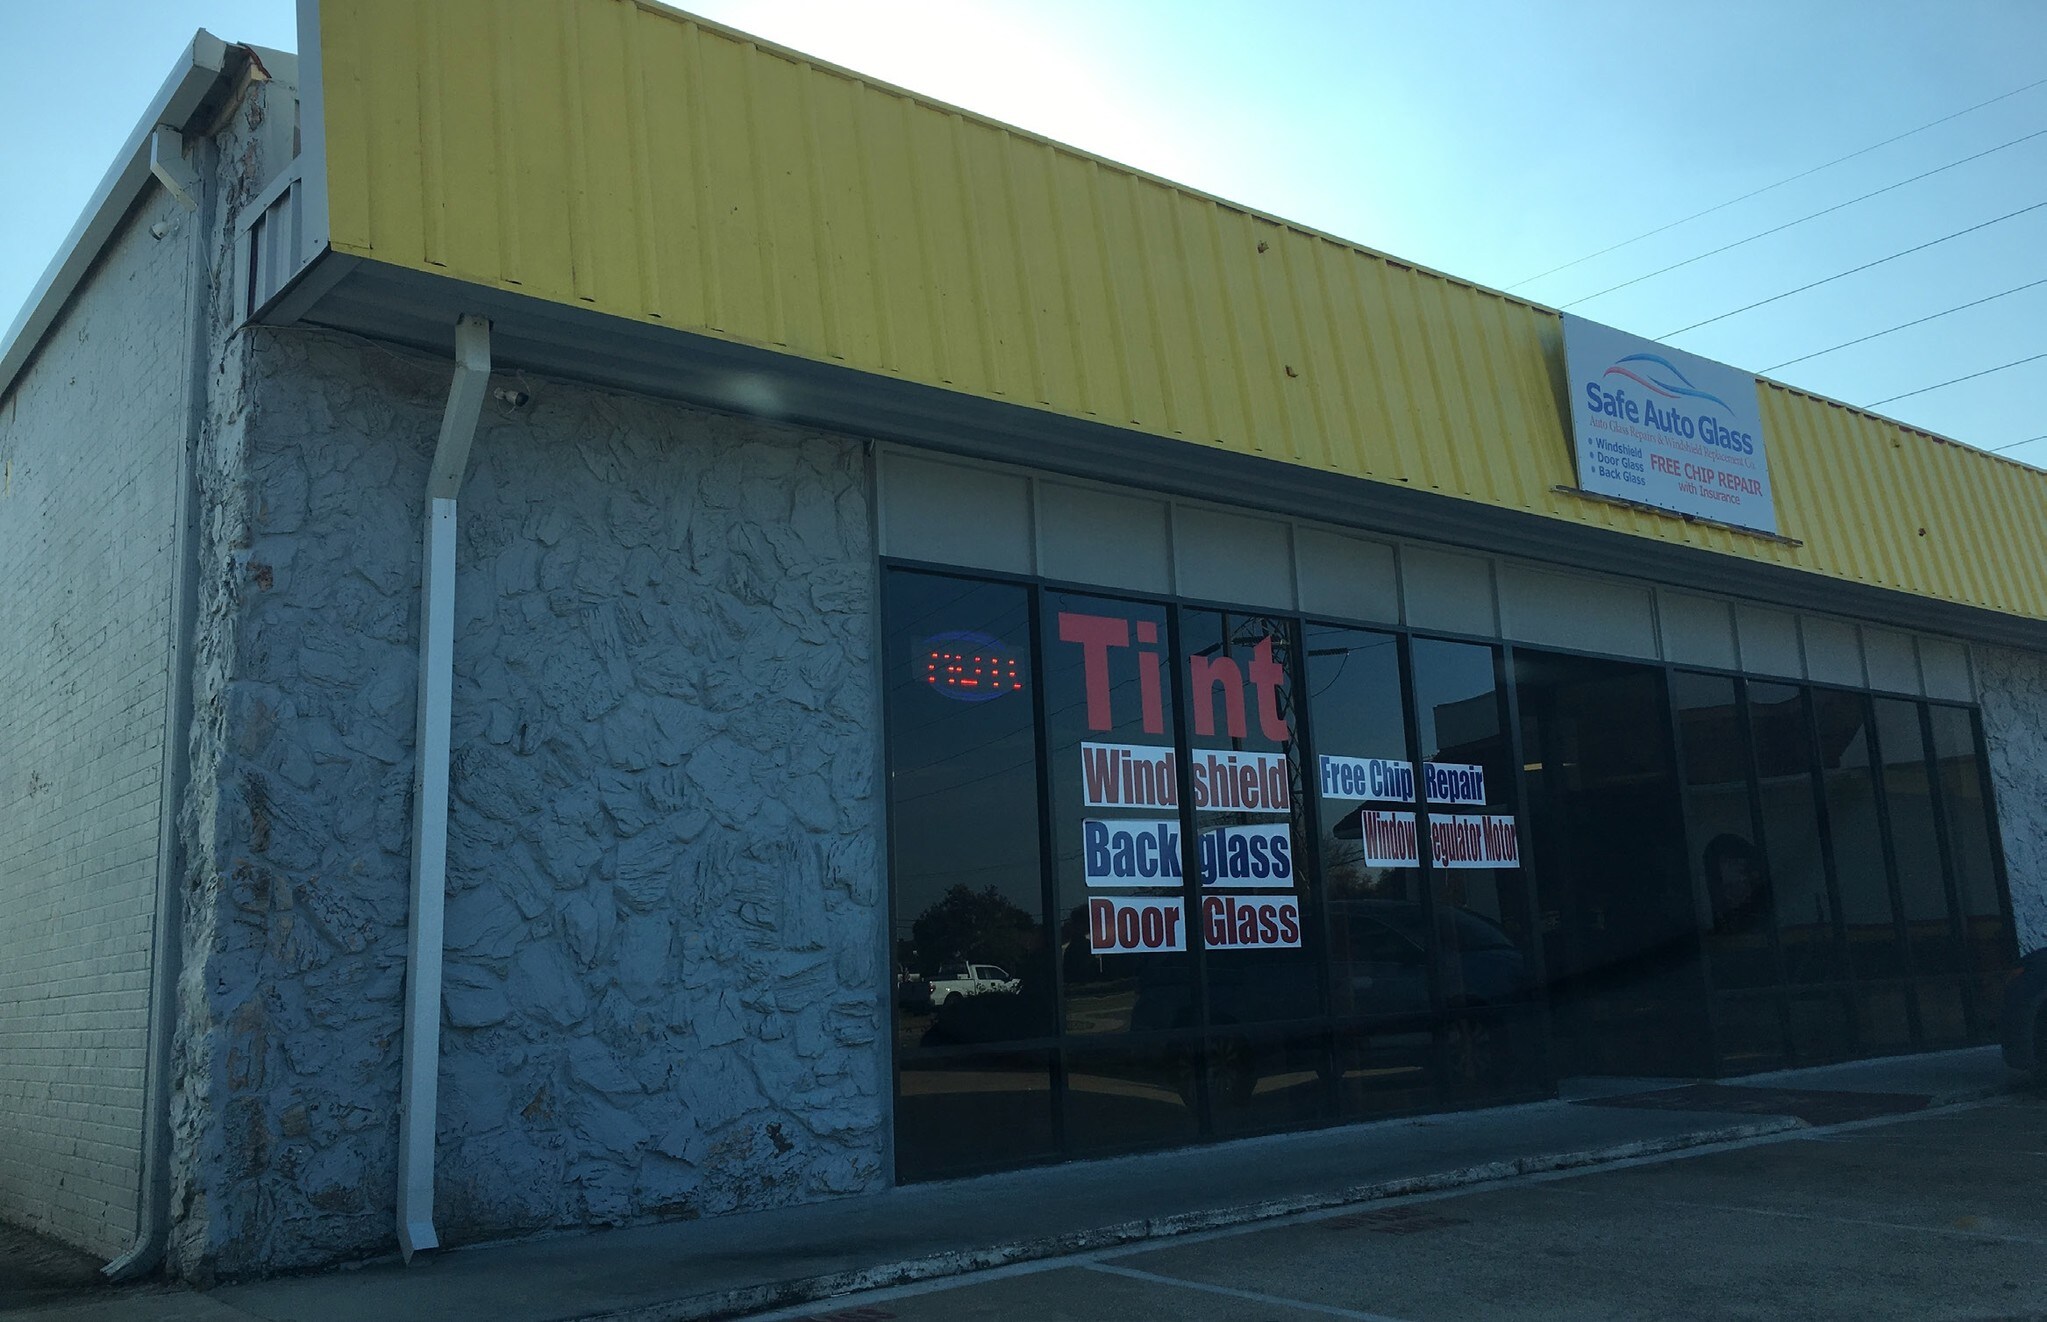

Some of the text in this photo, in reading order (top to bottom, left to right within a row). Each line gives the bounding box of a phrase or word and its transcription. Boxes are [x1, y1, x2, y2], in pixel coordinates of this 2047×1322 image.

[1586, 382, 1754, 455] Safe Auto Glass
[1590, 416, 1608, 432] Auto
[1609, 421, 1629, 437] Glass
[1630, 425, 1656, 444] Repairs
[1664, 435, 1702, 456] Windshield
[1703, 447, 1744, 468] Replacement
[1596, 438, 1643, 458] Windshield
[1597, 452, 1644, 473] Door Glass
[1599, 466, 1646, 486] Back Glass
[1650, 454, 1763, 496] FREE CHIP REPAIR
[1679, 482, 1741, 505] with Insurance
[1058, 612, 1288, 742] Tint
[1321, 756, 1483, 803] Free Chip Repair
[1364, 811, 1517, 867] Window egulator Motor
[1092, 896, 1299, 950] Door Glass
